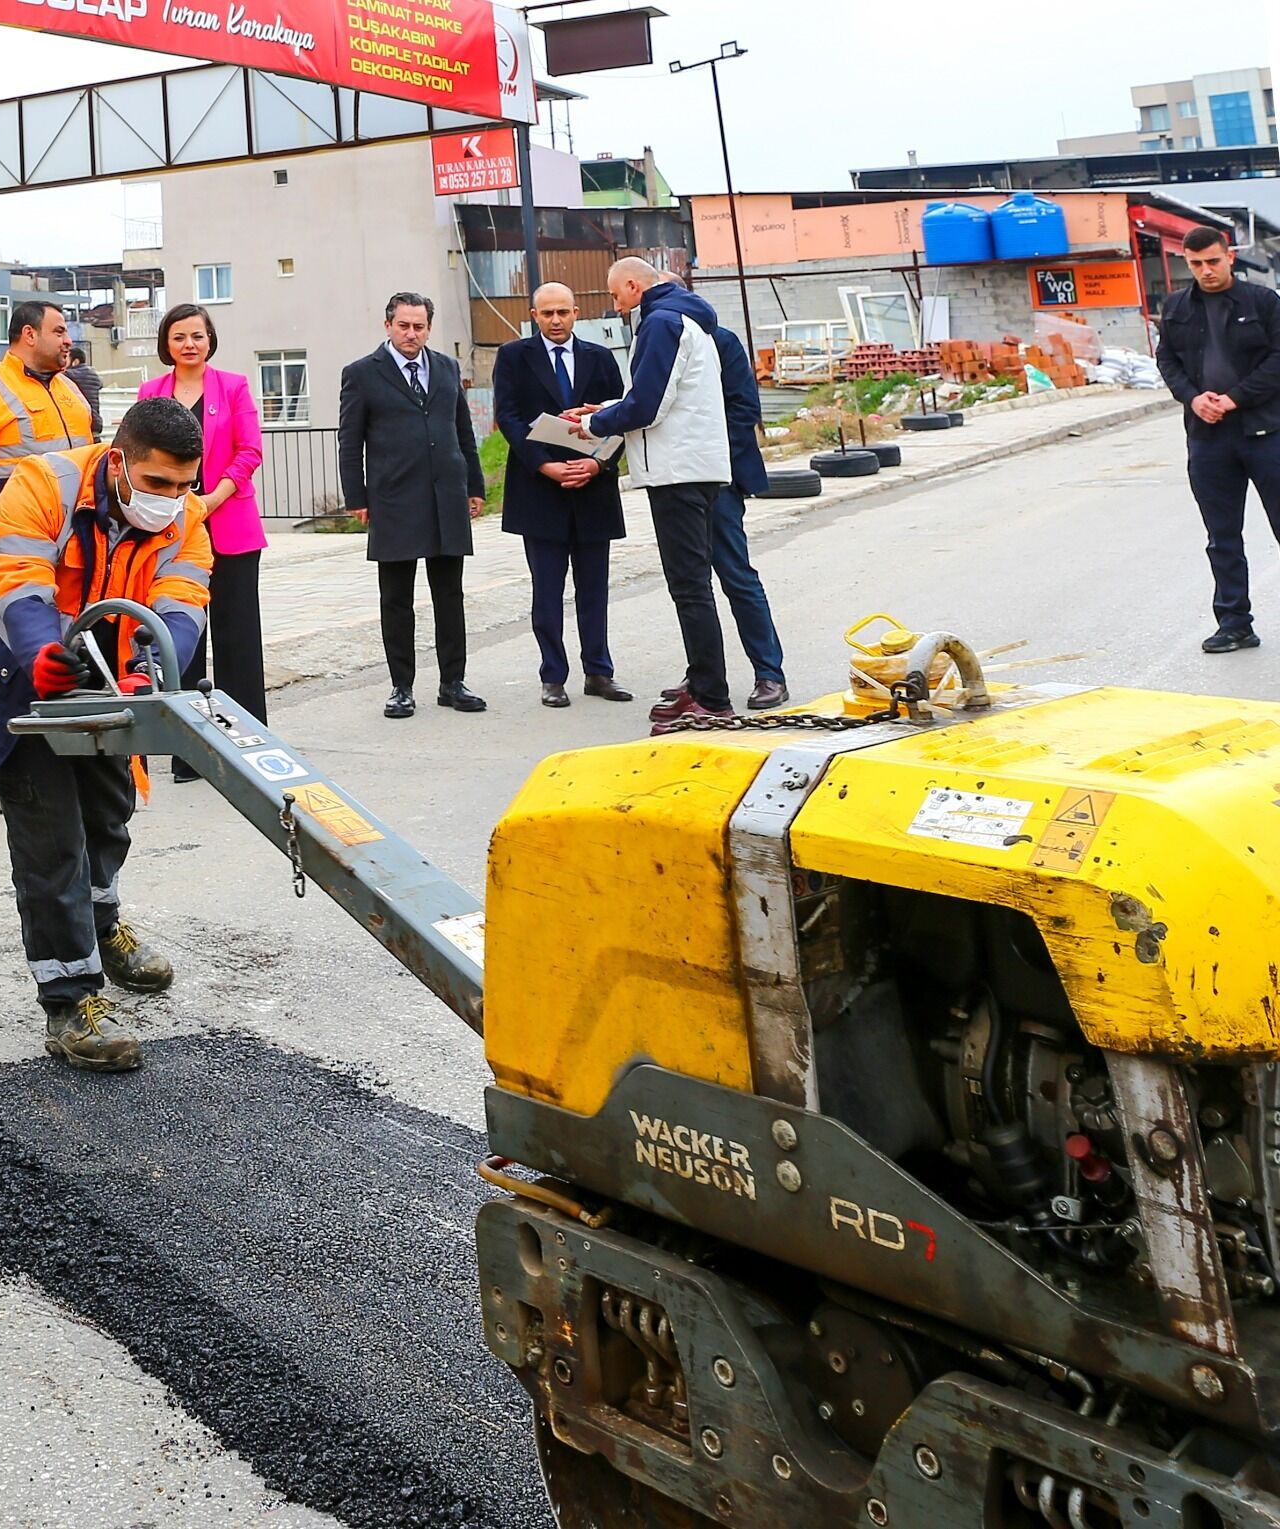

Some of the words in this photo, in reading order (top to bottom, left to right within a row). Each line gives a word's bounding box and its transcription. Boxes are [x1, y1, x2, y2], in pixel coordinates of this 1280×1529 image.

[226, 2, 316, 56] Karakaya
[414, 11, 463, 35] PARKE
[350, 36, 413, 63] KOMPLE
[350, 57, 454, 93] DEKORASYON
[437, 161, 466, 175] TURAN
[466, 156, 513, 172] KARAKAYA
[449, 172, 470, 189] 0553
[471, 170, 486, 188] 257
[488, 169, 499, 186] 31
[500, 167, 513, 184] 28
[628, 1109, 754, 1173] WACKER
[634, 1138, 758, 1201] NEUSON
